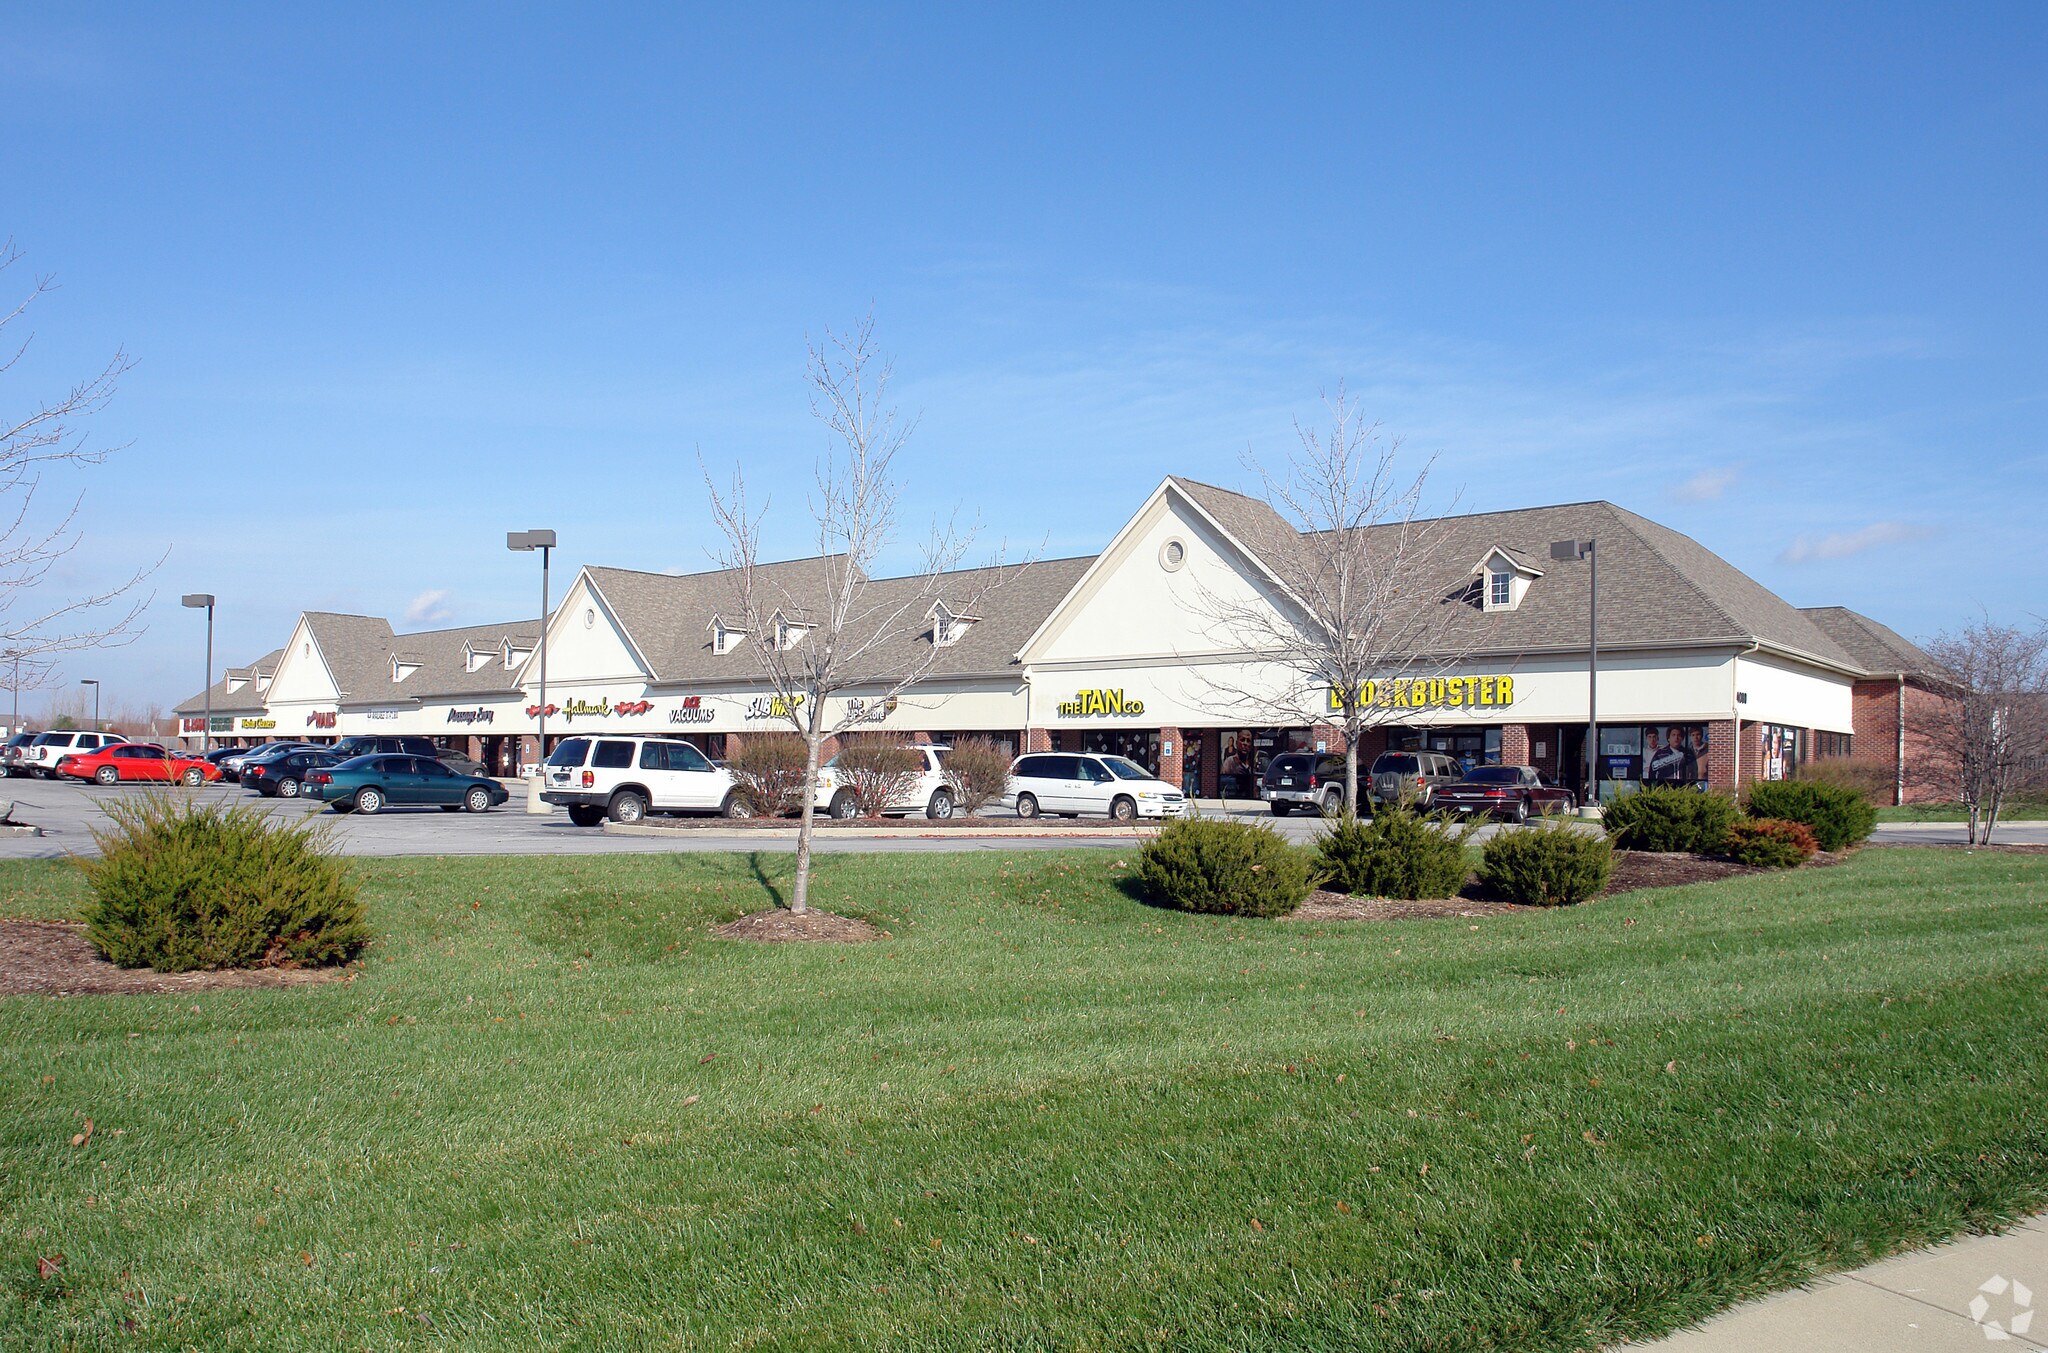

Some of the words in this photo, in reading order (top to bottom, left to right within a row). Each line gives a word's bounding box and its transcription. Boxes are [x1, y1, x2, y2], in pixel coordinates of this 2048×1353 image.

[1059, 702, 1080, 715] THE
[1078, 688, 1124, 714] TAN
[1331, 676, 1513, 708] BOCKBUSTER
[562, 697, 612, 722] Hallmark
[683, 697, 701, 708] ACE
[849, 698, 863, 709] The
[670, 709, 714, 722] VACUUMS
